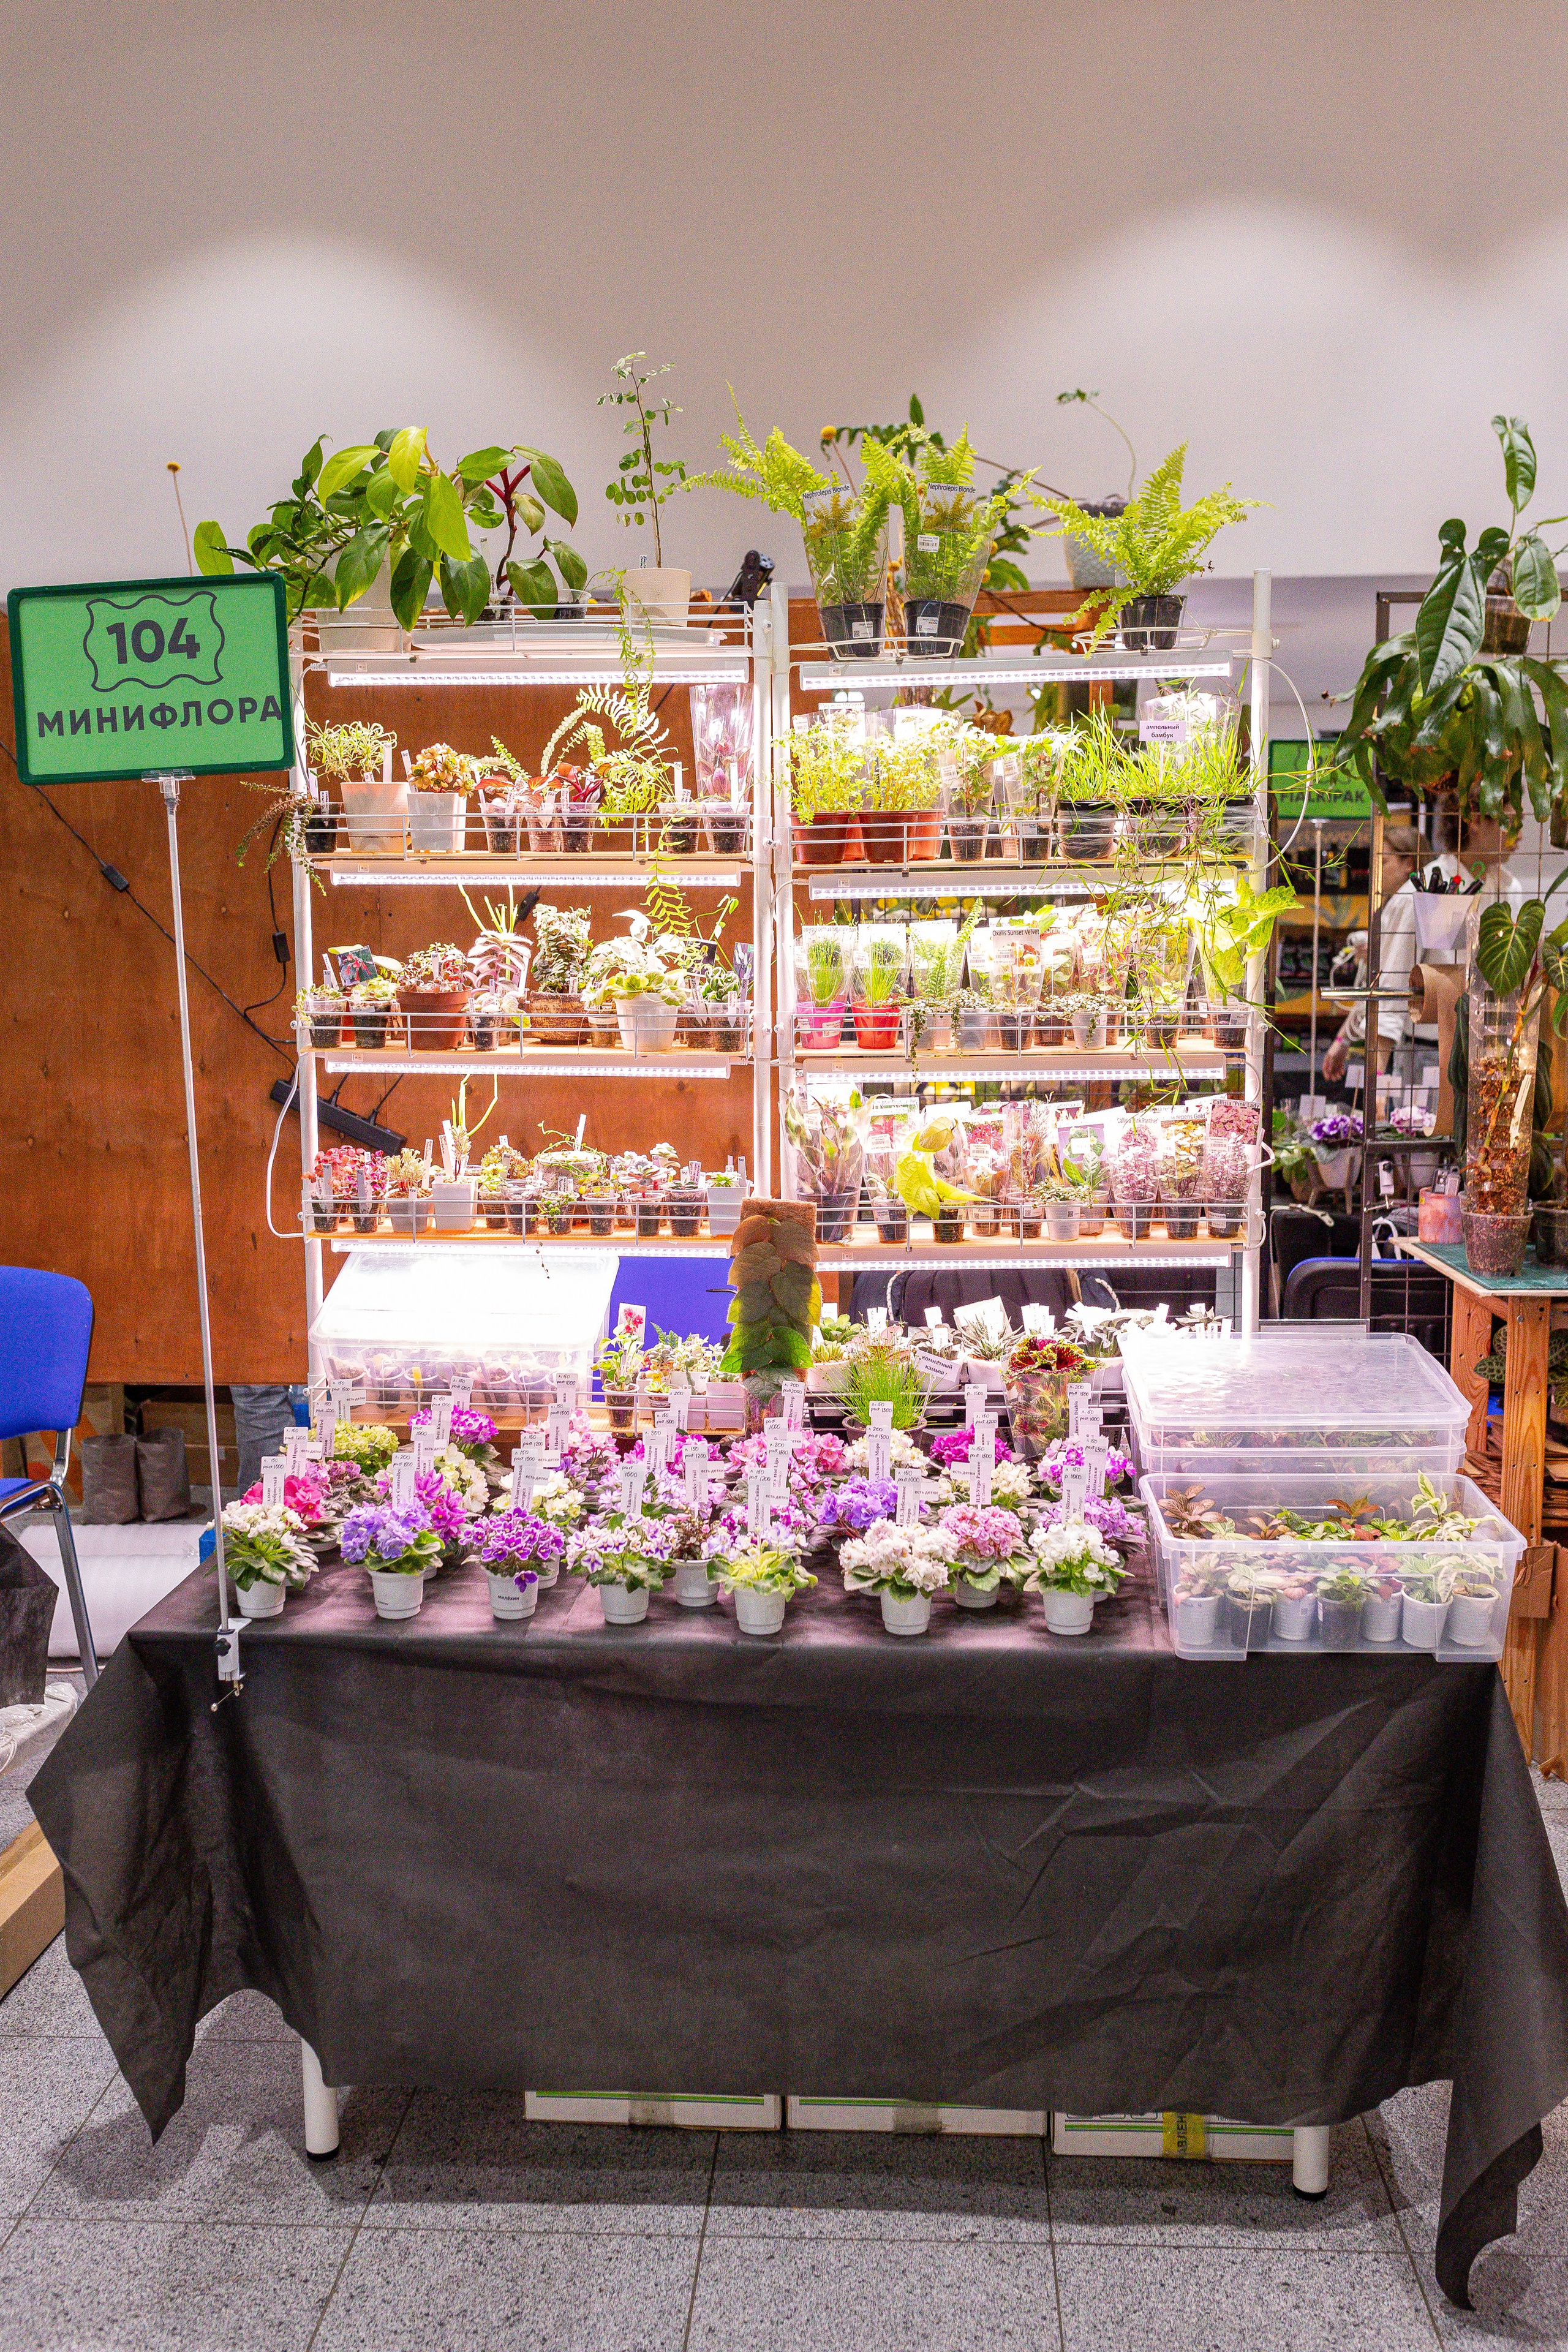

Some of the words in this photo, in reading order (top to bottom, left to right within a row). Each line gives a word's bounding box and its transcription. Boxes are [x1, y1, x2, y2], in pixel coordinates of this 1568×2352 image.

[802, 489, 831, 500] Nephrolepis
[832, 484, 850, 494] Blonde
[928, 483, 957, 492] Nephrolepis
[106, 617, 201, 665] 104
[37, 695, 282, 737] МИНИФЛОРА
[922, 1355, 953, 1370] комнатный
[925, 1365, 945, 1376] камыш
